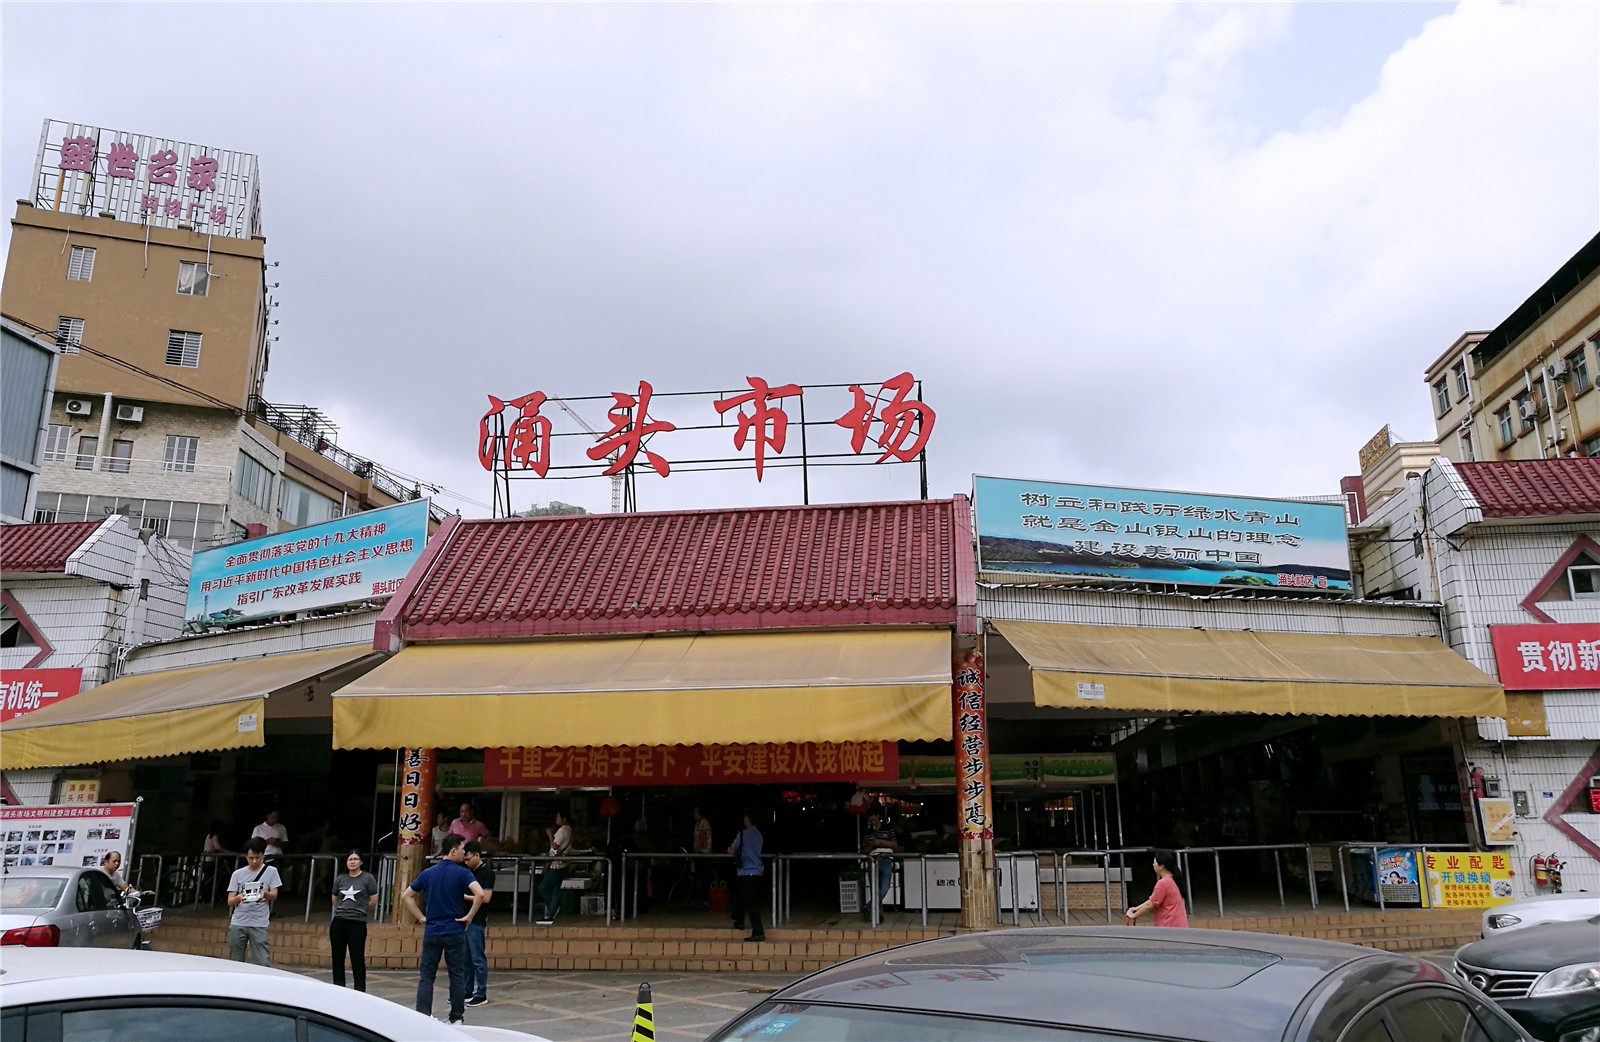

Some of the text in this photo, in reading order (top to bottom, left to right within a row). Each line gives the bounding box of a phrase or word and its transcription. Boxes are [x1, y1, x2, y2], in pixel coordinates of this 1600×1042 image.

[58, 135, 218, 191] 盛世名家
[140, 193, 227, 224] 购物广场
[478, 371, 936, 483] 涌头市场
[1020, 492, 1300, 527] 树立和践行绿水青山
[224, 522, 387, 569] 全面贯彻落实党的十九大精神
[1021, 514, 1302, 548] 就是金山银山的理念
[200, 538, 414, 593] 用习近平新时代中国特色社会主义思想
[1073, 539, 1262, 565] 建设美丽中国
[236, 571, 362, 606] 指引广东改革发展实践
[1517, 639, 1600, 673] 贯彻新
[956, 668, 988, 827] 诚信经营步步高
[1426, 855, 1505, 870] 专业配匙
[1440, 871, 1492, 884] 开锁换锁
